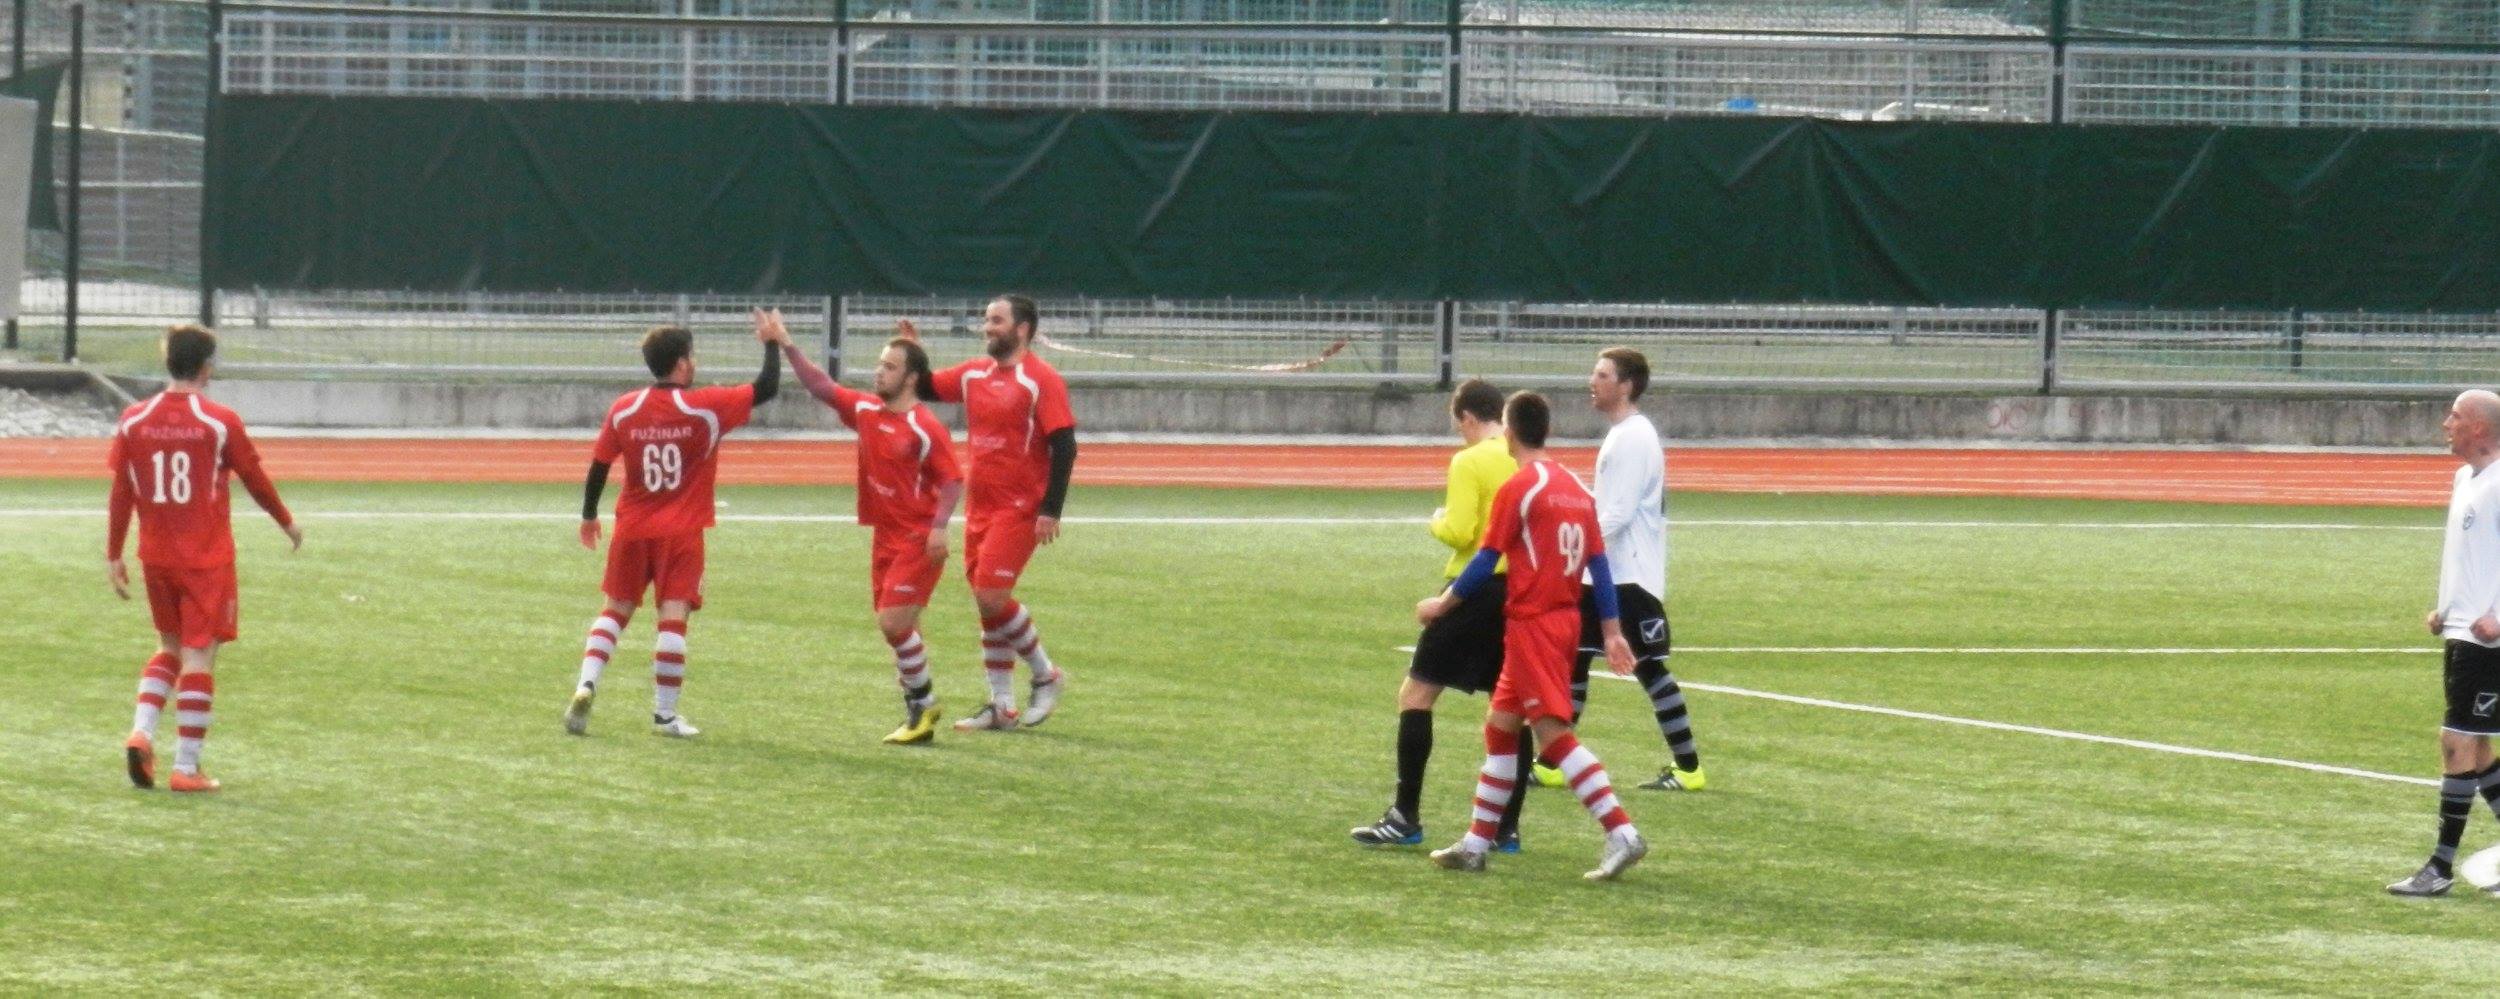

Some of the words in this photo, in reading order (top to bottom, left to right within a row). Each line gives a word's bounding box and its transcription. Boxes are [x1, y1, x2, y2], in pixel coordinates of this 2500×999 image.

[630, 425, 692, 440] FUŽINAR
[151, 450, 192, 504] 18
[643, 443, 682, 492] 69
